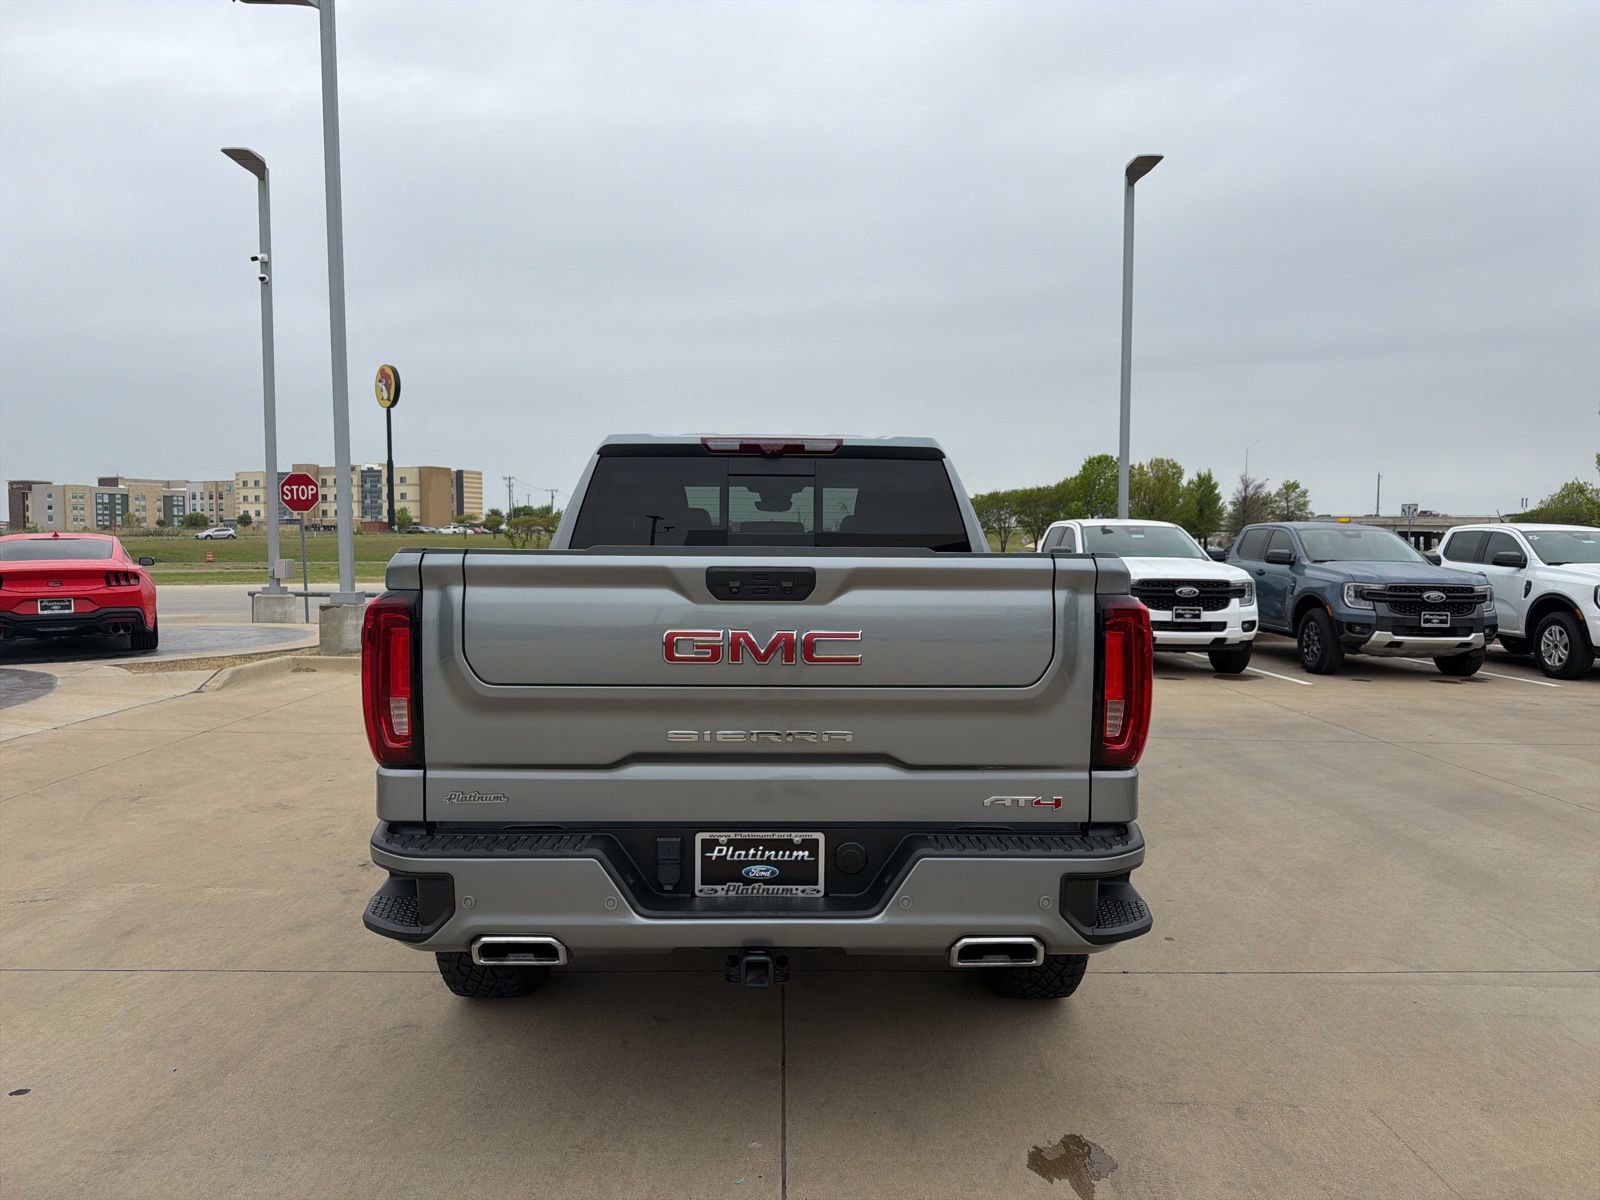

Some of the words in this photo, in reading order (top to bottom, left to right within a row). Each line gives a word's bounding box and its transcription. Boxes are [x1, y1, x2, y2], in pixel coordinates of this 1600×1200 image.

[283, 485, 317, 500] STOP
[663, 629, 862, 665] GMC
[667, 730, 853, 743] SIERRA
[443, 790, 509, 804] Platinum
[983, 795, 1063, 811] AT4
[705, 846, 815, 861] Platinum
[749, 867, 772, 877] Ford
[724, 883, 799, 896] Platinum
